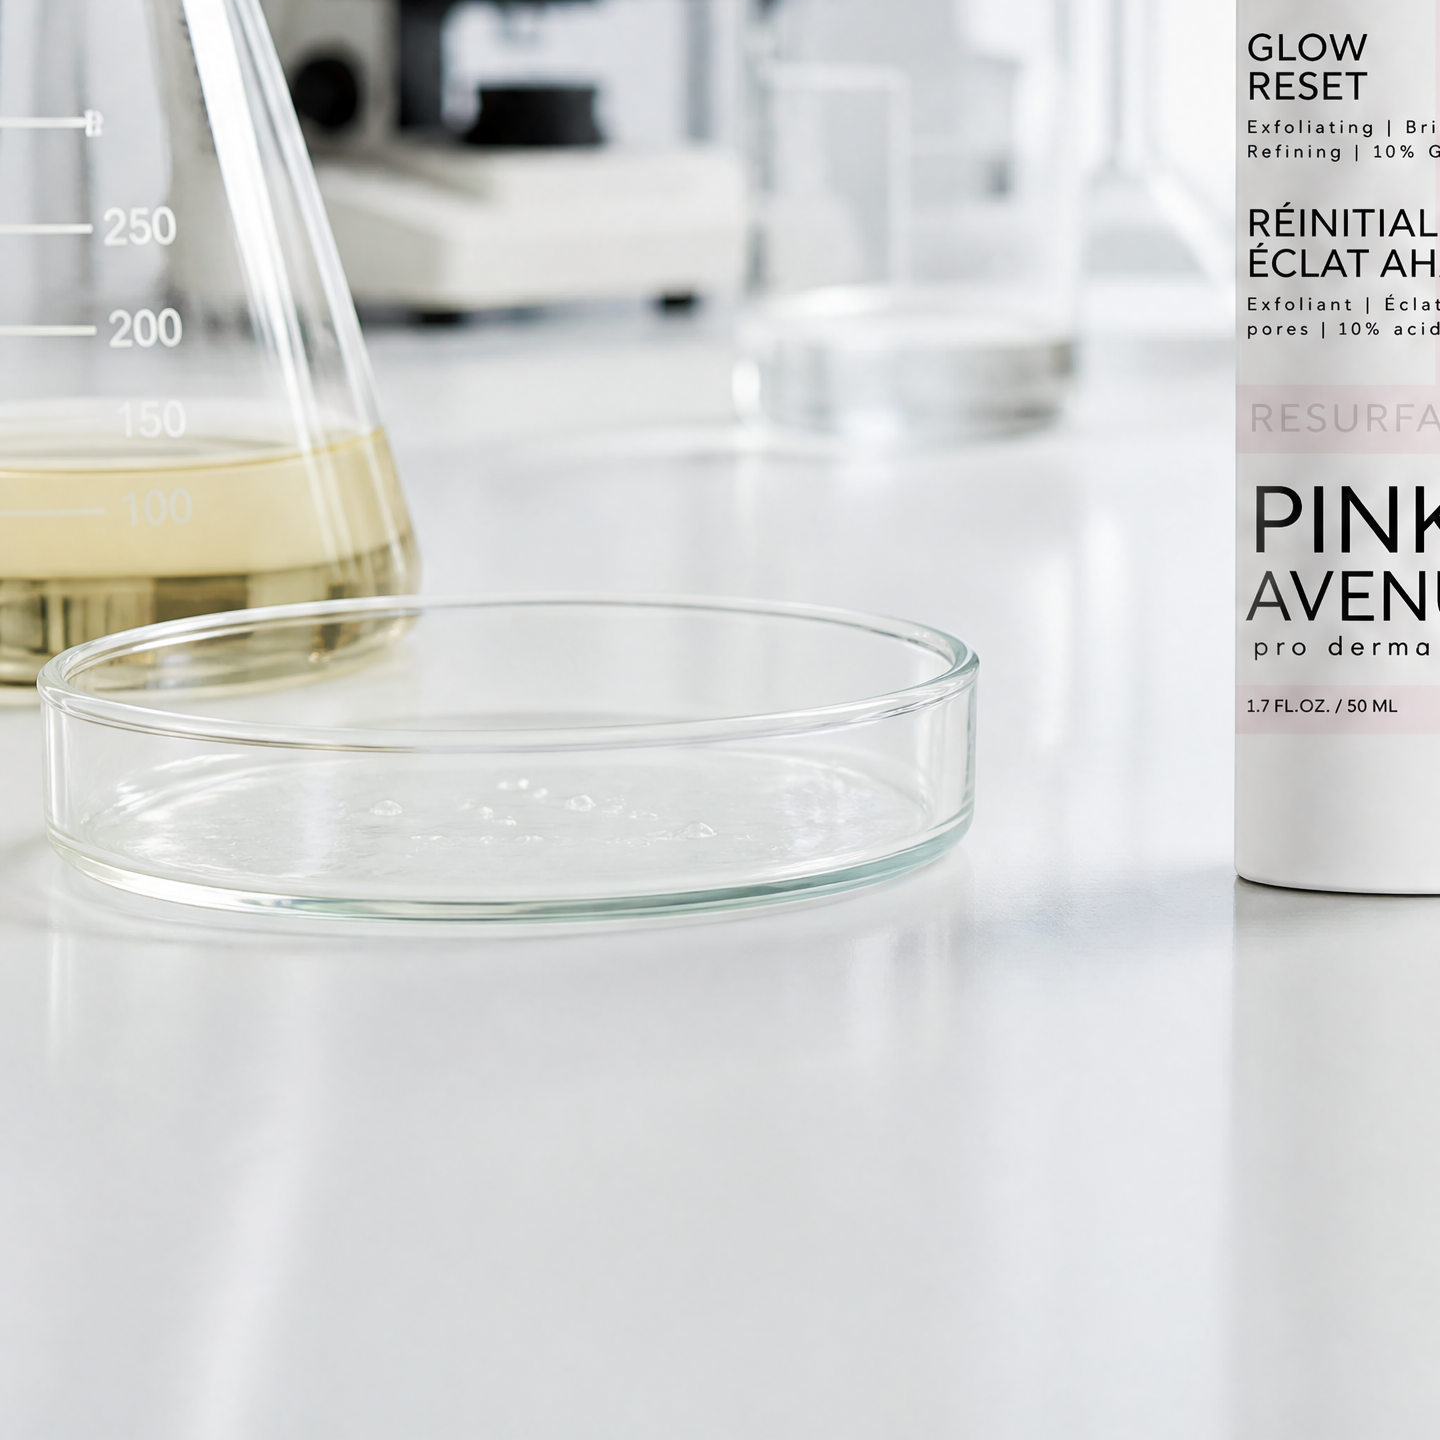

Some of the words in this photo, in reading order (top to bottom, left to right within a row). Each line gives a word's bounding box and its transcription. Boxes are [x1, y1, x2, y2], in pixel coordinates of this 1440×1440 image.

[1247, 32, 1368, 62] GLOW
[1249, 71, 1368, 101] RESET
[1247, 119, 1373, 138] Exfoliating
[1247, 144, 1341, 162] Refining
[1373, 144, 1415, 159] 10%
[103, 206, 177, 246] 250
[1249, 242, 1369, 278] ÉCLAT
[1247, 296, 1352, 312] Exfoliant
[108, 307, 183, 348] 200
[1247, 324, 1309, 339] pores
[1338, 321, 1380, 336] 10%
[117, 399, 187, 439] 150
[122, 486, 193, 527] 100
[1254, 640, 1307, 660] pro
[1328, 635, 1430, 656] derma
[1246, 698, 1270, 713] 1.7
[1334, 698, 1343, 715] /
[1347, 698, 1368, 714] 50
[1372, 698, 1398, 714] ML
